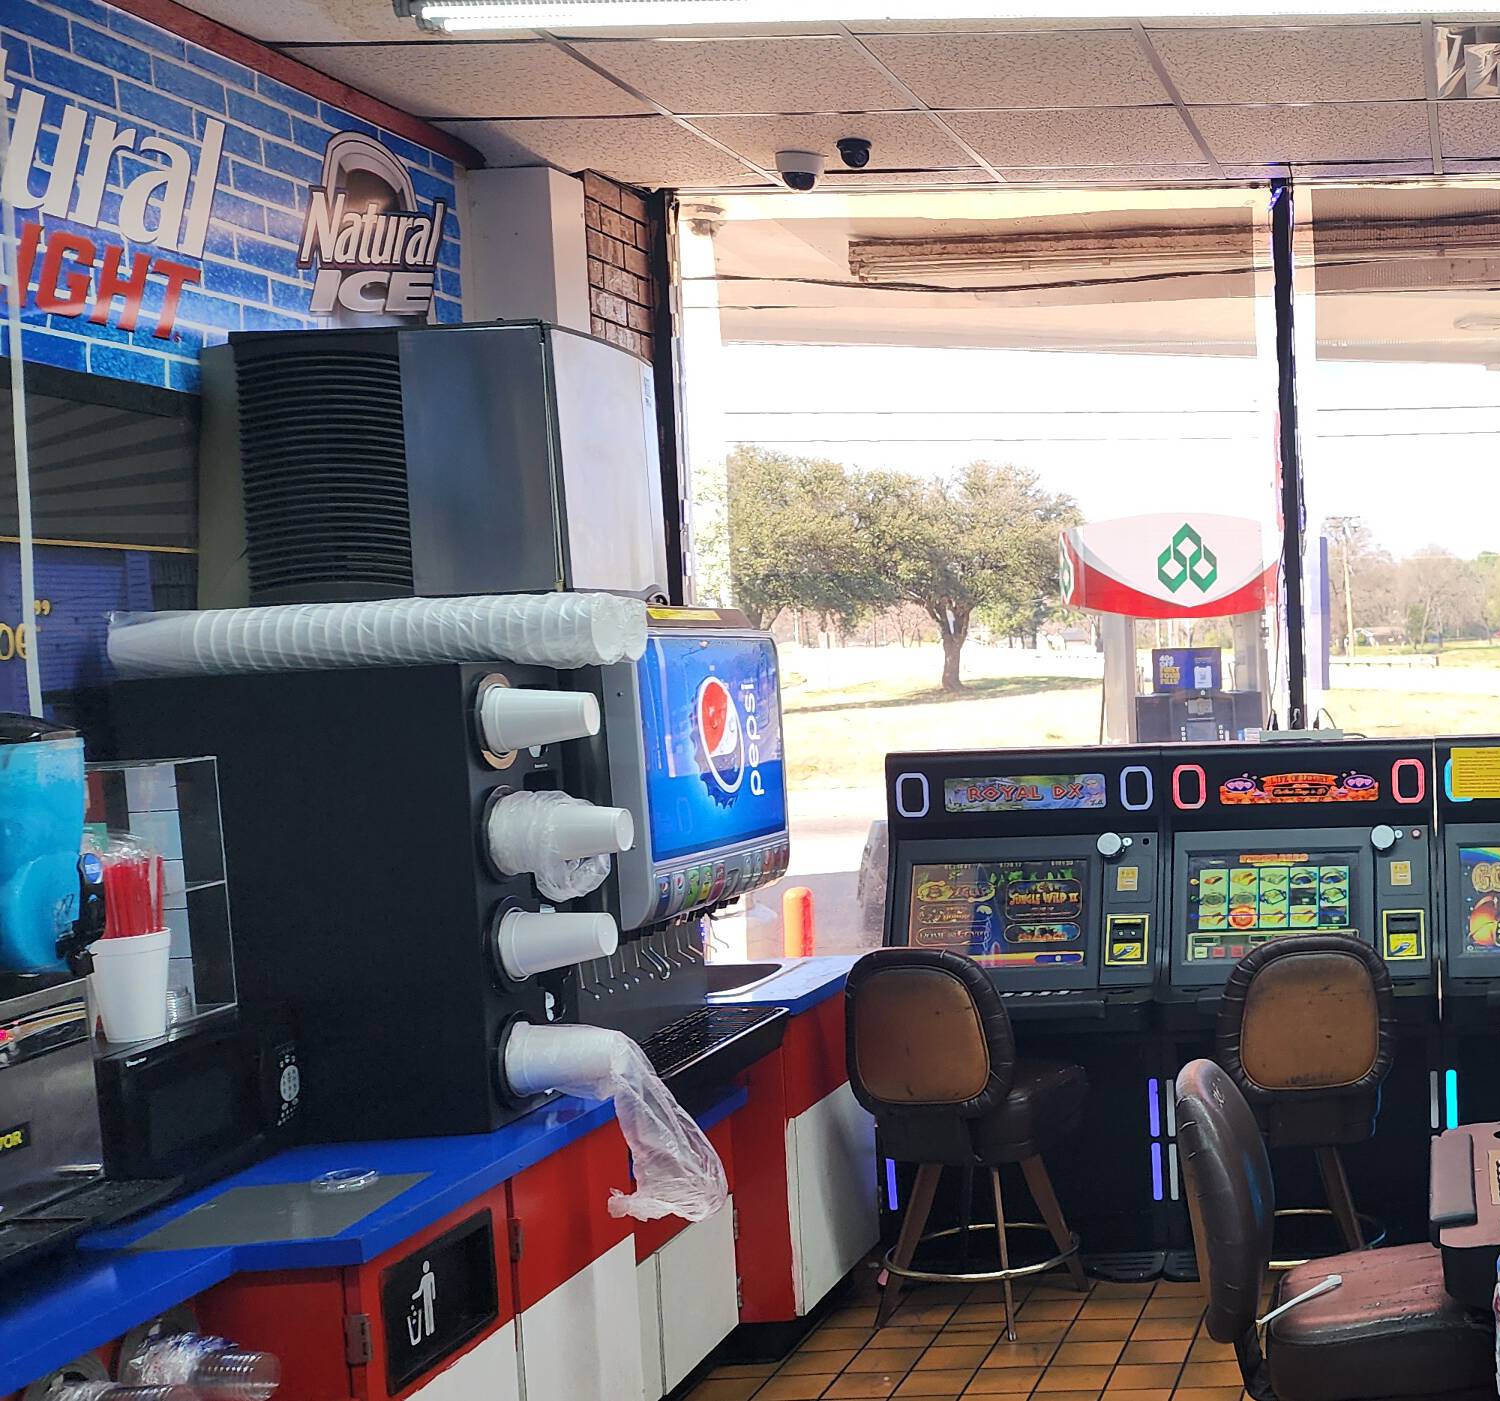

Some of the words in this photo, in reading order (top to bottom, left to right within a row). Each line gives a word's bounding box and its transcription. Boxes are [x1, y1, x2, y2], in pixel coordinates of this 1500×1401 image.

[300, 185, 447, 268] Natural
[310, 270, 436, 316] ICE
[741, 682, 764, 796] pepsi
[967, 784, 1042, 803] ROYAL
[1053, 782, 1085, 799] DX
[1009, 893, 1041, 906] JUNGLE
[1042, 892, 1068, 905] WILD
